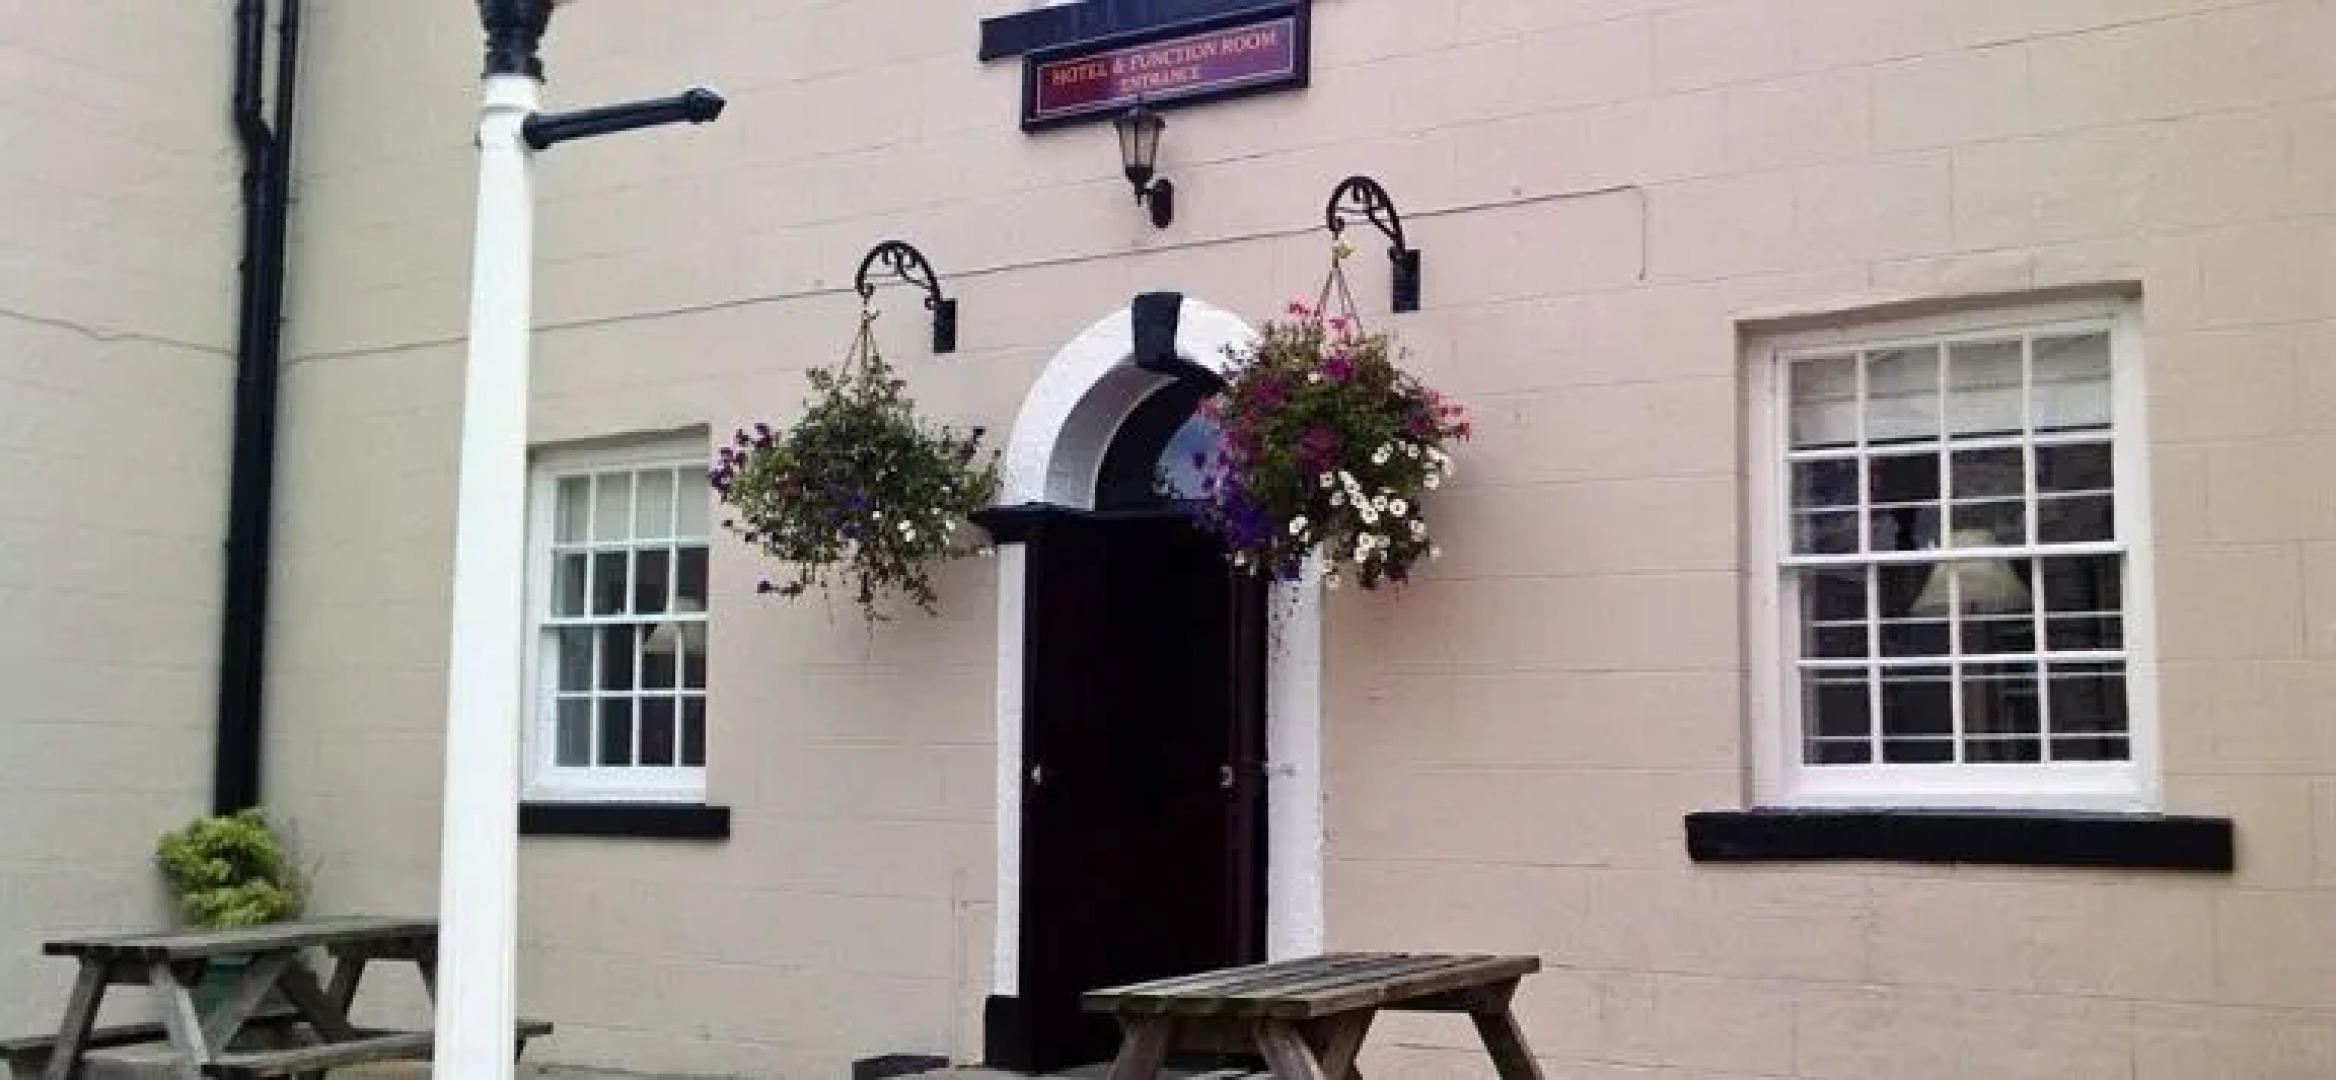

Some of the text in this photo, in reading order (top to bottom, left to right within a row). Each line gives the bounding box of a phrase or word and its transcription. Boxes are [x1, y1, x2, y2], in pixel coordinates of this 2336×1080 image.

[1051, 29, 1277, 86] HOTEL & FUNCTION ROOM
[1120, 65, 1199, 92] ENTRANCE
